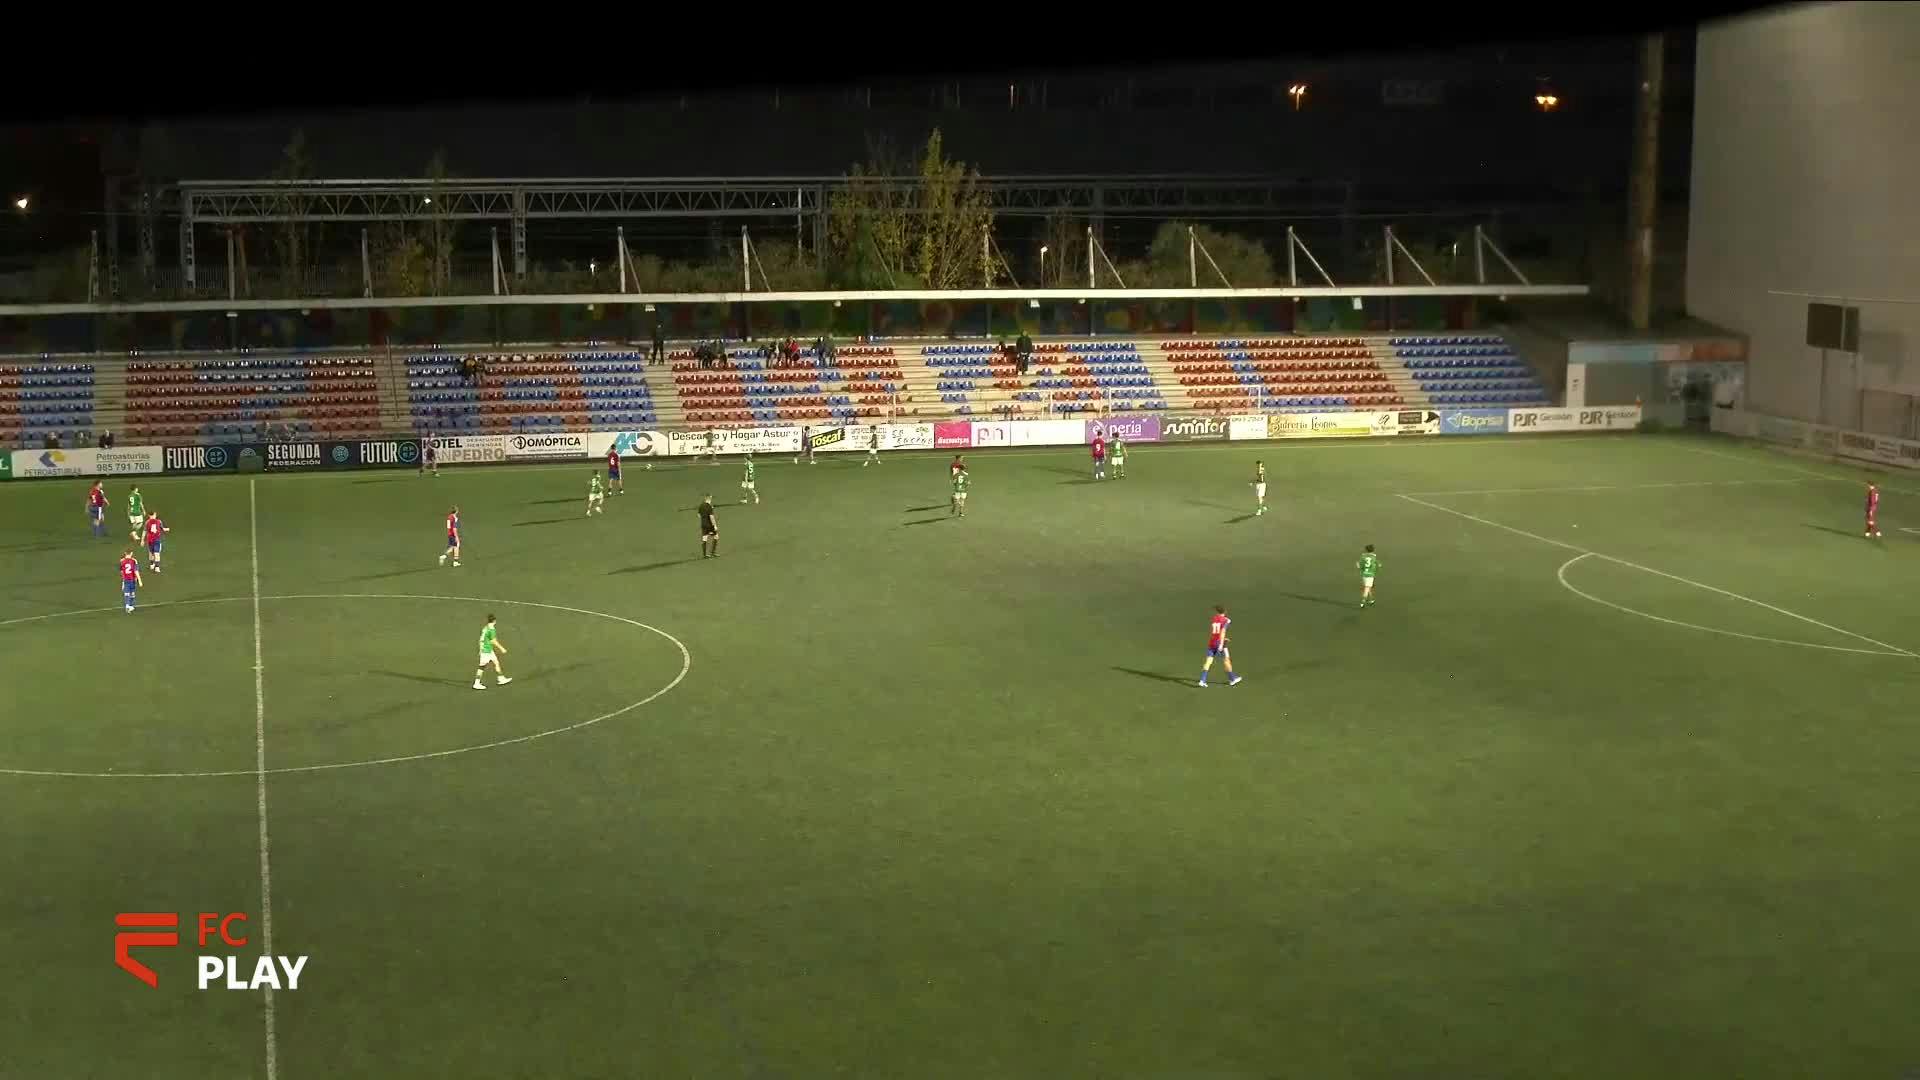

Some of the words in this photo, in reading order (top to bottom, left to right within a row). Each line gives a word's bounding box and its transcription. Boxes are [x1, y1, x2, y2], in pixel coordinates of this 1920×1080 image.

[1513, 413, 1537, 427] PJR
[1580, 411, 1603, 425] PJR
[1163, 418, 1226, 435] suminfor
[672, 432, 720, 440] Descao
[722, 433, 728, 441] y
[730, 430, 761, 440] Hogar
[763, 429, 790, 438] Astur
[97, 453, 150, 462] Petroasturias
[268, 444, 321, 460] SEGUNDA
[97, 463, 112, 472] 985
[116, 463, 131, 472] 791
[134, 462, 150, 471] 708
[129, 496, 135, 506] 9
[151, 523, 157, 534] 4
[1365, 557, 1372, 568] 3
[125, 563, 132, 574] 2
[1212, 622, 1221, 634] 11
